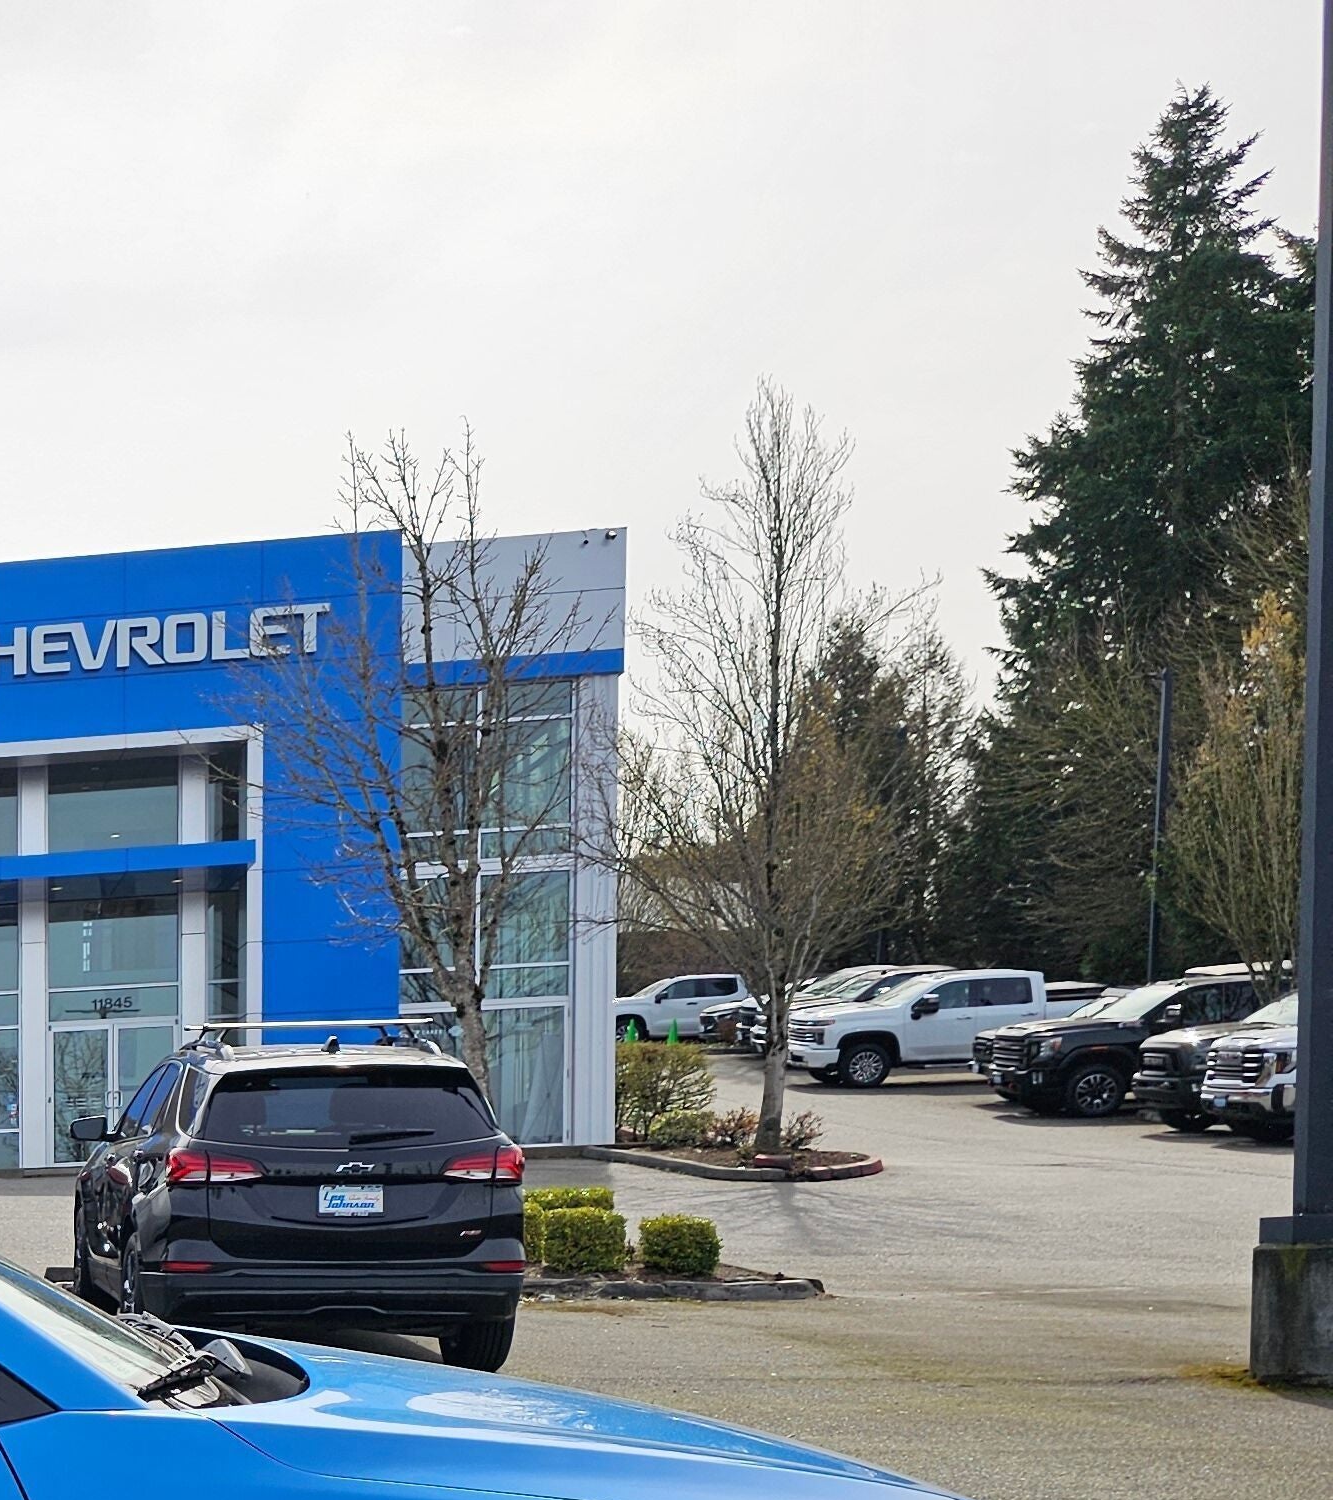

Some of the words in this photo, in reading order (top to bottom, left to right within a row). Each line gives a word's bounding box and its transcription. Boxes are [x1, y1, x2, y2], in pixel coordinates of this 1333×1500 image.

[91, 996, 133, 1010] 11845
[324, 1191, 345, 1201] Lee
[325, 1197, 375, 1209] Johnson
